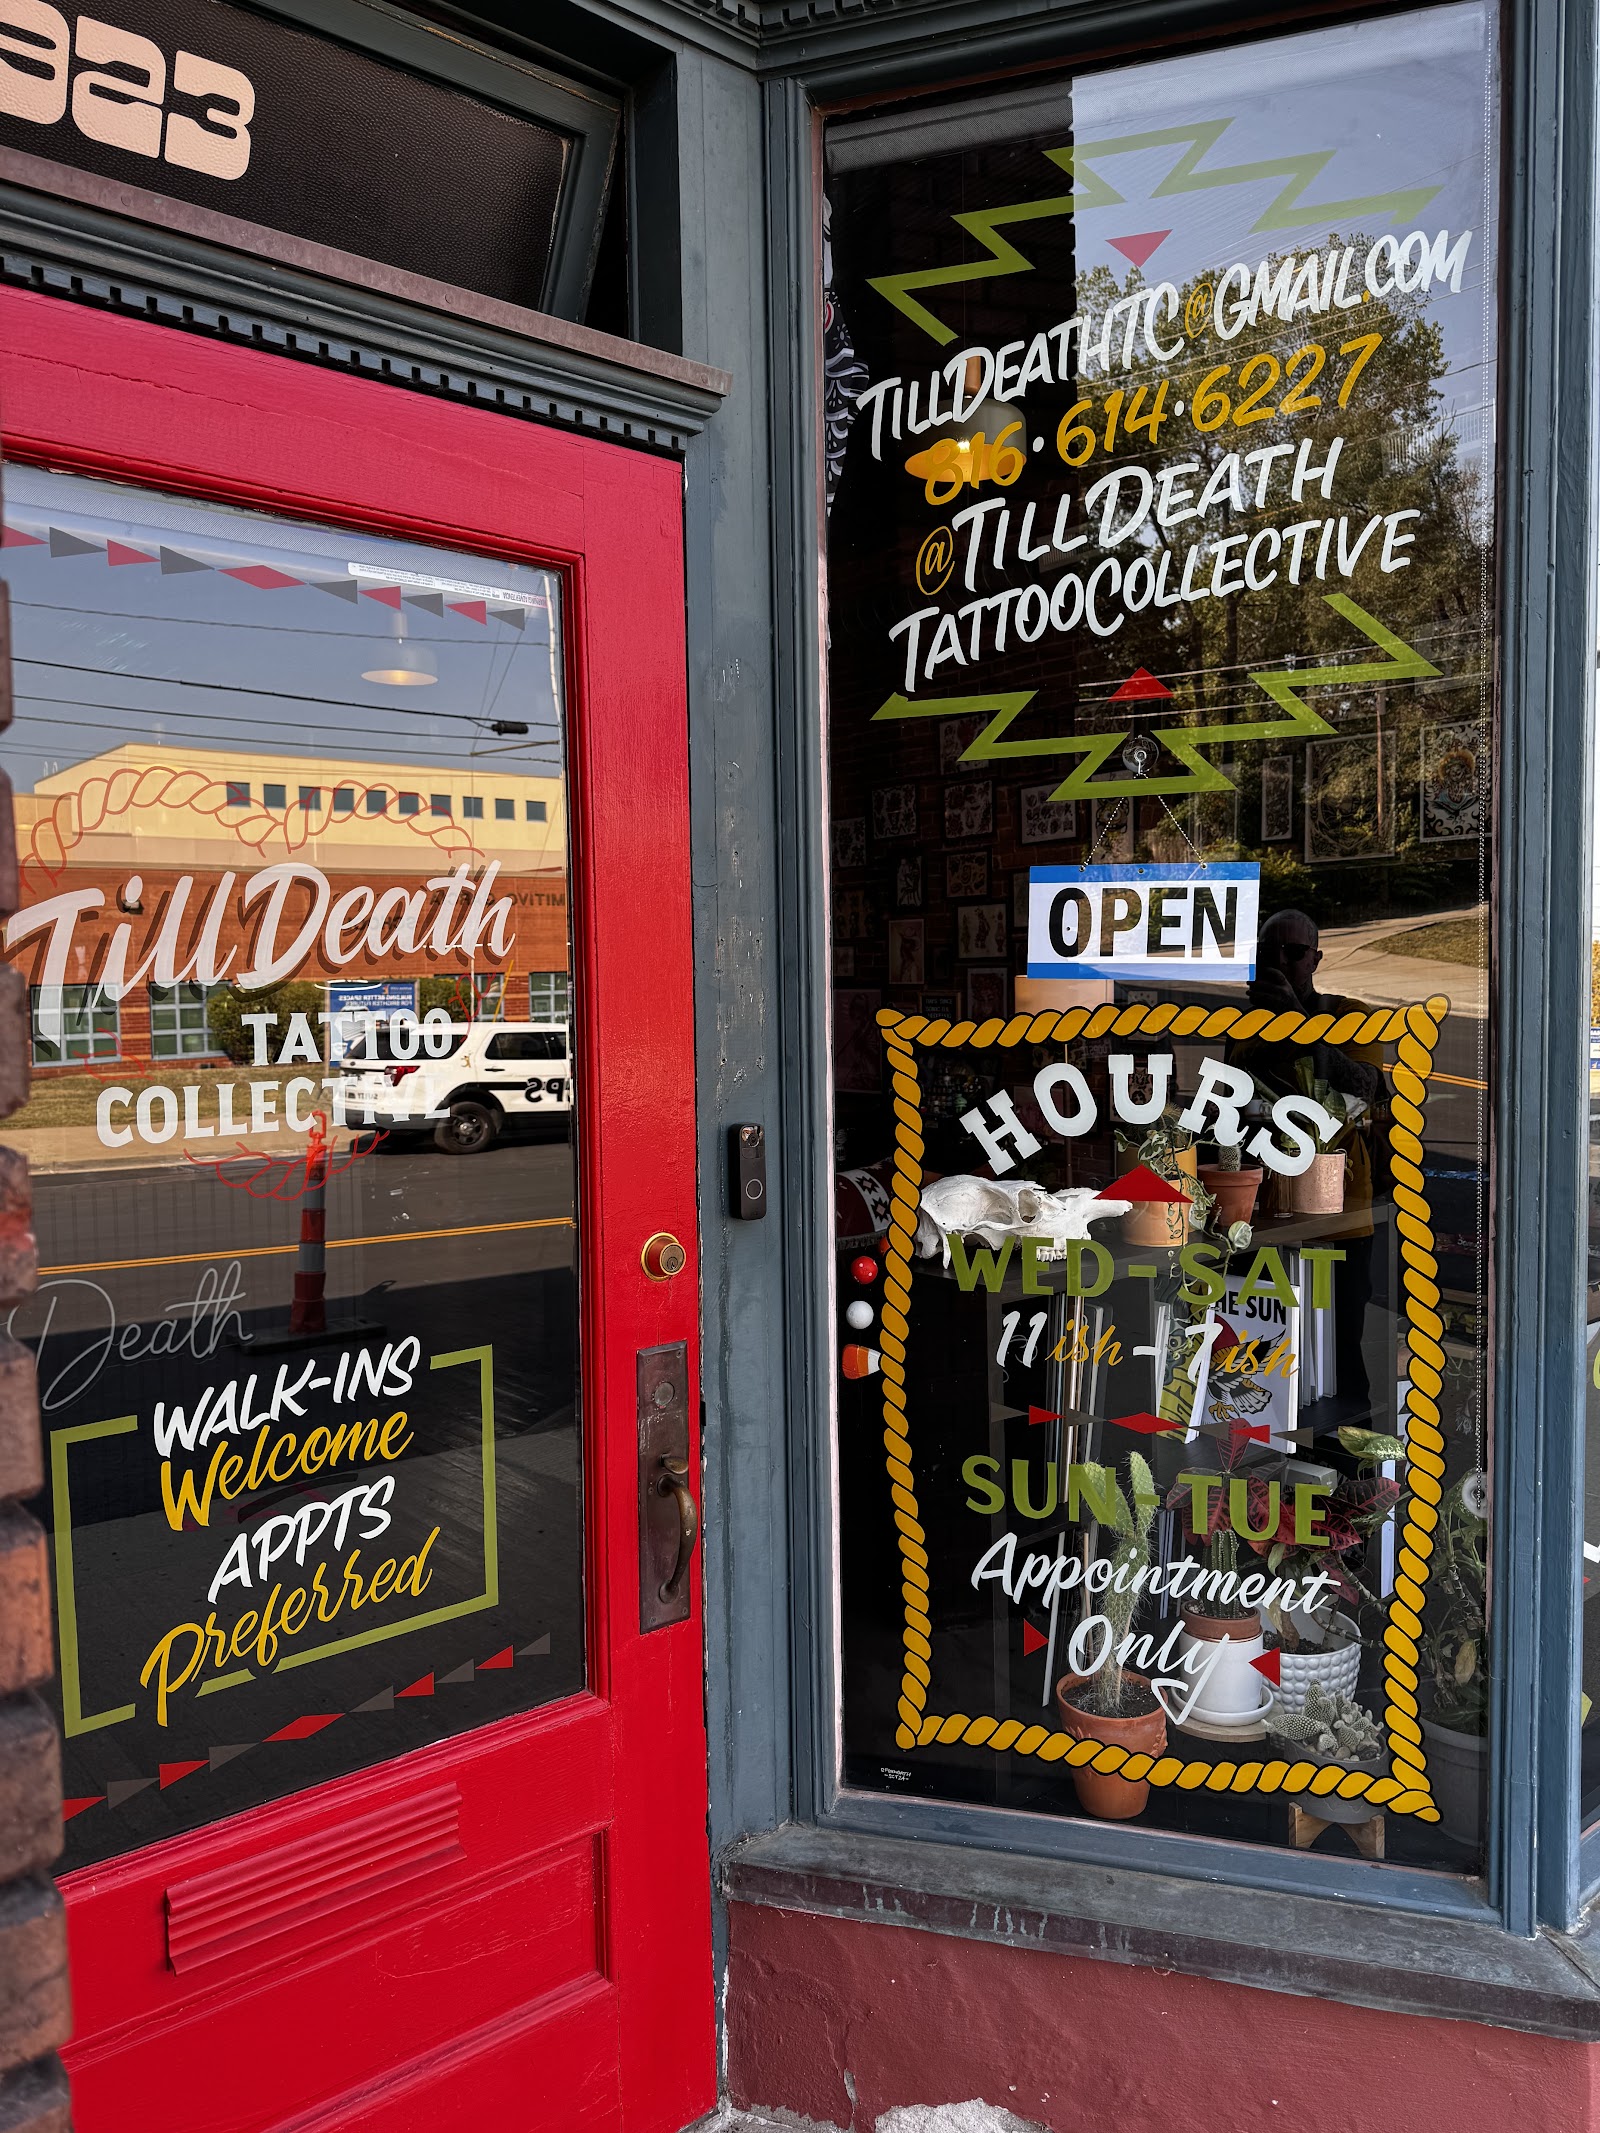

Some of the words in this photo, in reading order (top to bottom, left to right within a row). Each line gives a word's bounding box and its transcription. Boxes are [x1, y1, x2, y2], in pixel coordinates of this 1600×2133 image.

[6, 871, 238, 1049] Till
[235, 859, 517, 991] Death
[1047, 885, 1239, 959] OPEN
[241, 1008, 453, 1067] TATTOO
[95, 1074, 453, 1148] COLLECTIVE
[958, 1052, 1346, 1177] HOURS
[1213, 1290, 1240, 1316] HE
[153, 1335, 421, 1458] WALK-INS
[160, 1411, 415, 1532] Welcome
[207, 1475, 396, 1604] APPTS
[970, 1531, 1342, 1614] Appointment
[1067, 1613, 1230, 1726] Only
